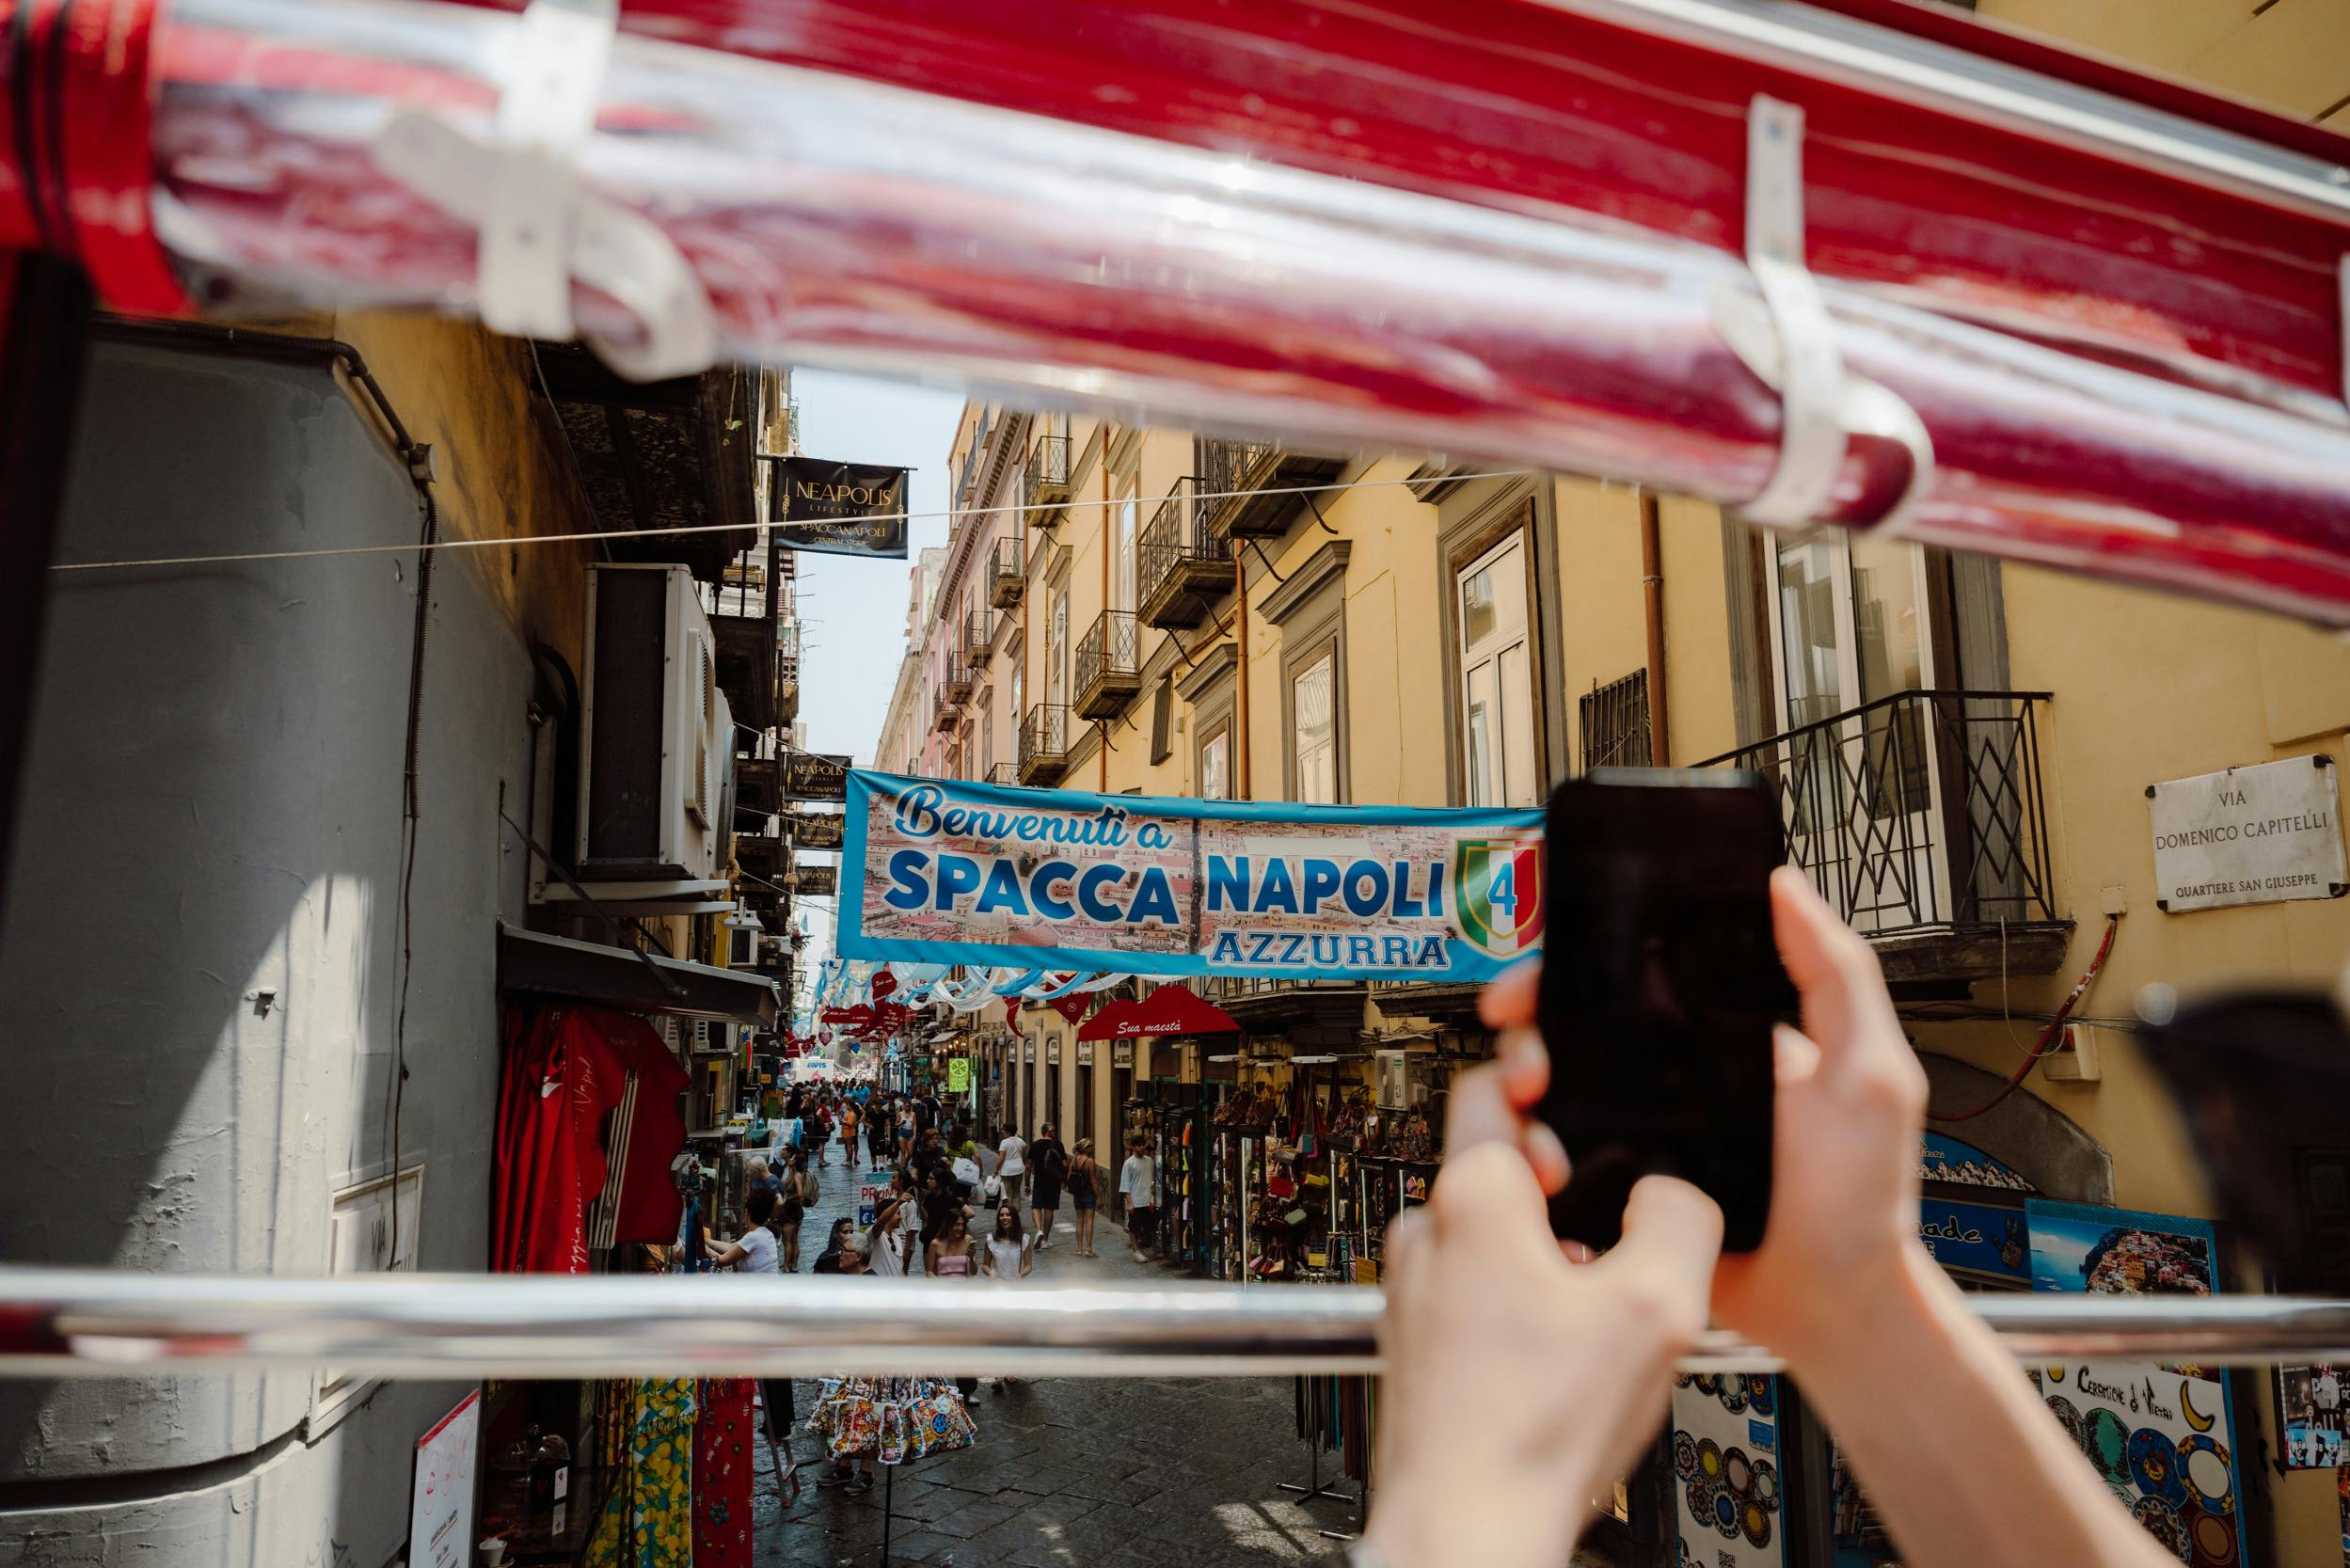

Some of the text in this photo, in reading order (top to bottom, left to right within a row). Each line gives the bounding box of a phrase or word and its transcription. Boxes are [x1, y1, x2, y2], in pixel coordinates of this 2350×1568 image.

[796, 481, 892, 506] NEAPOLIS
[809, 504, 873, 516] LIFESTYLE
[800, 523, 885, 537] SPACCANAPOLI
[795, 765, 844, 776] NEAPOLIS
[2218, 790, 2247, 808] VIA
[895, 784, 1173, 849] Benvenuti a
[2155, 812, 2328, 850] DOMENICO CAPITELLI
[884, 848, 1445, 926] SPACCA NAPOLI
[1487, 862, 1517, 916] 4
[2175, 873, 2318, 898] QUARTIERE SAN GIUSEPPE
[1210, 930, 1452, 969] AZZURRA
[1117, 1019, 1182, 1035] Sua maestà
[1919, 1215, 1983, 1243] ade
